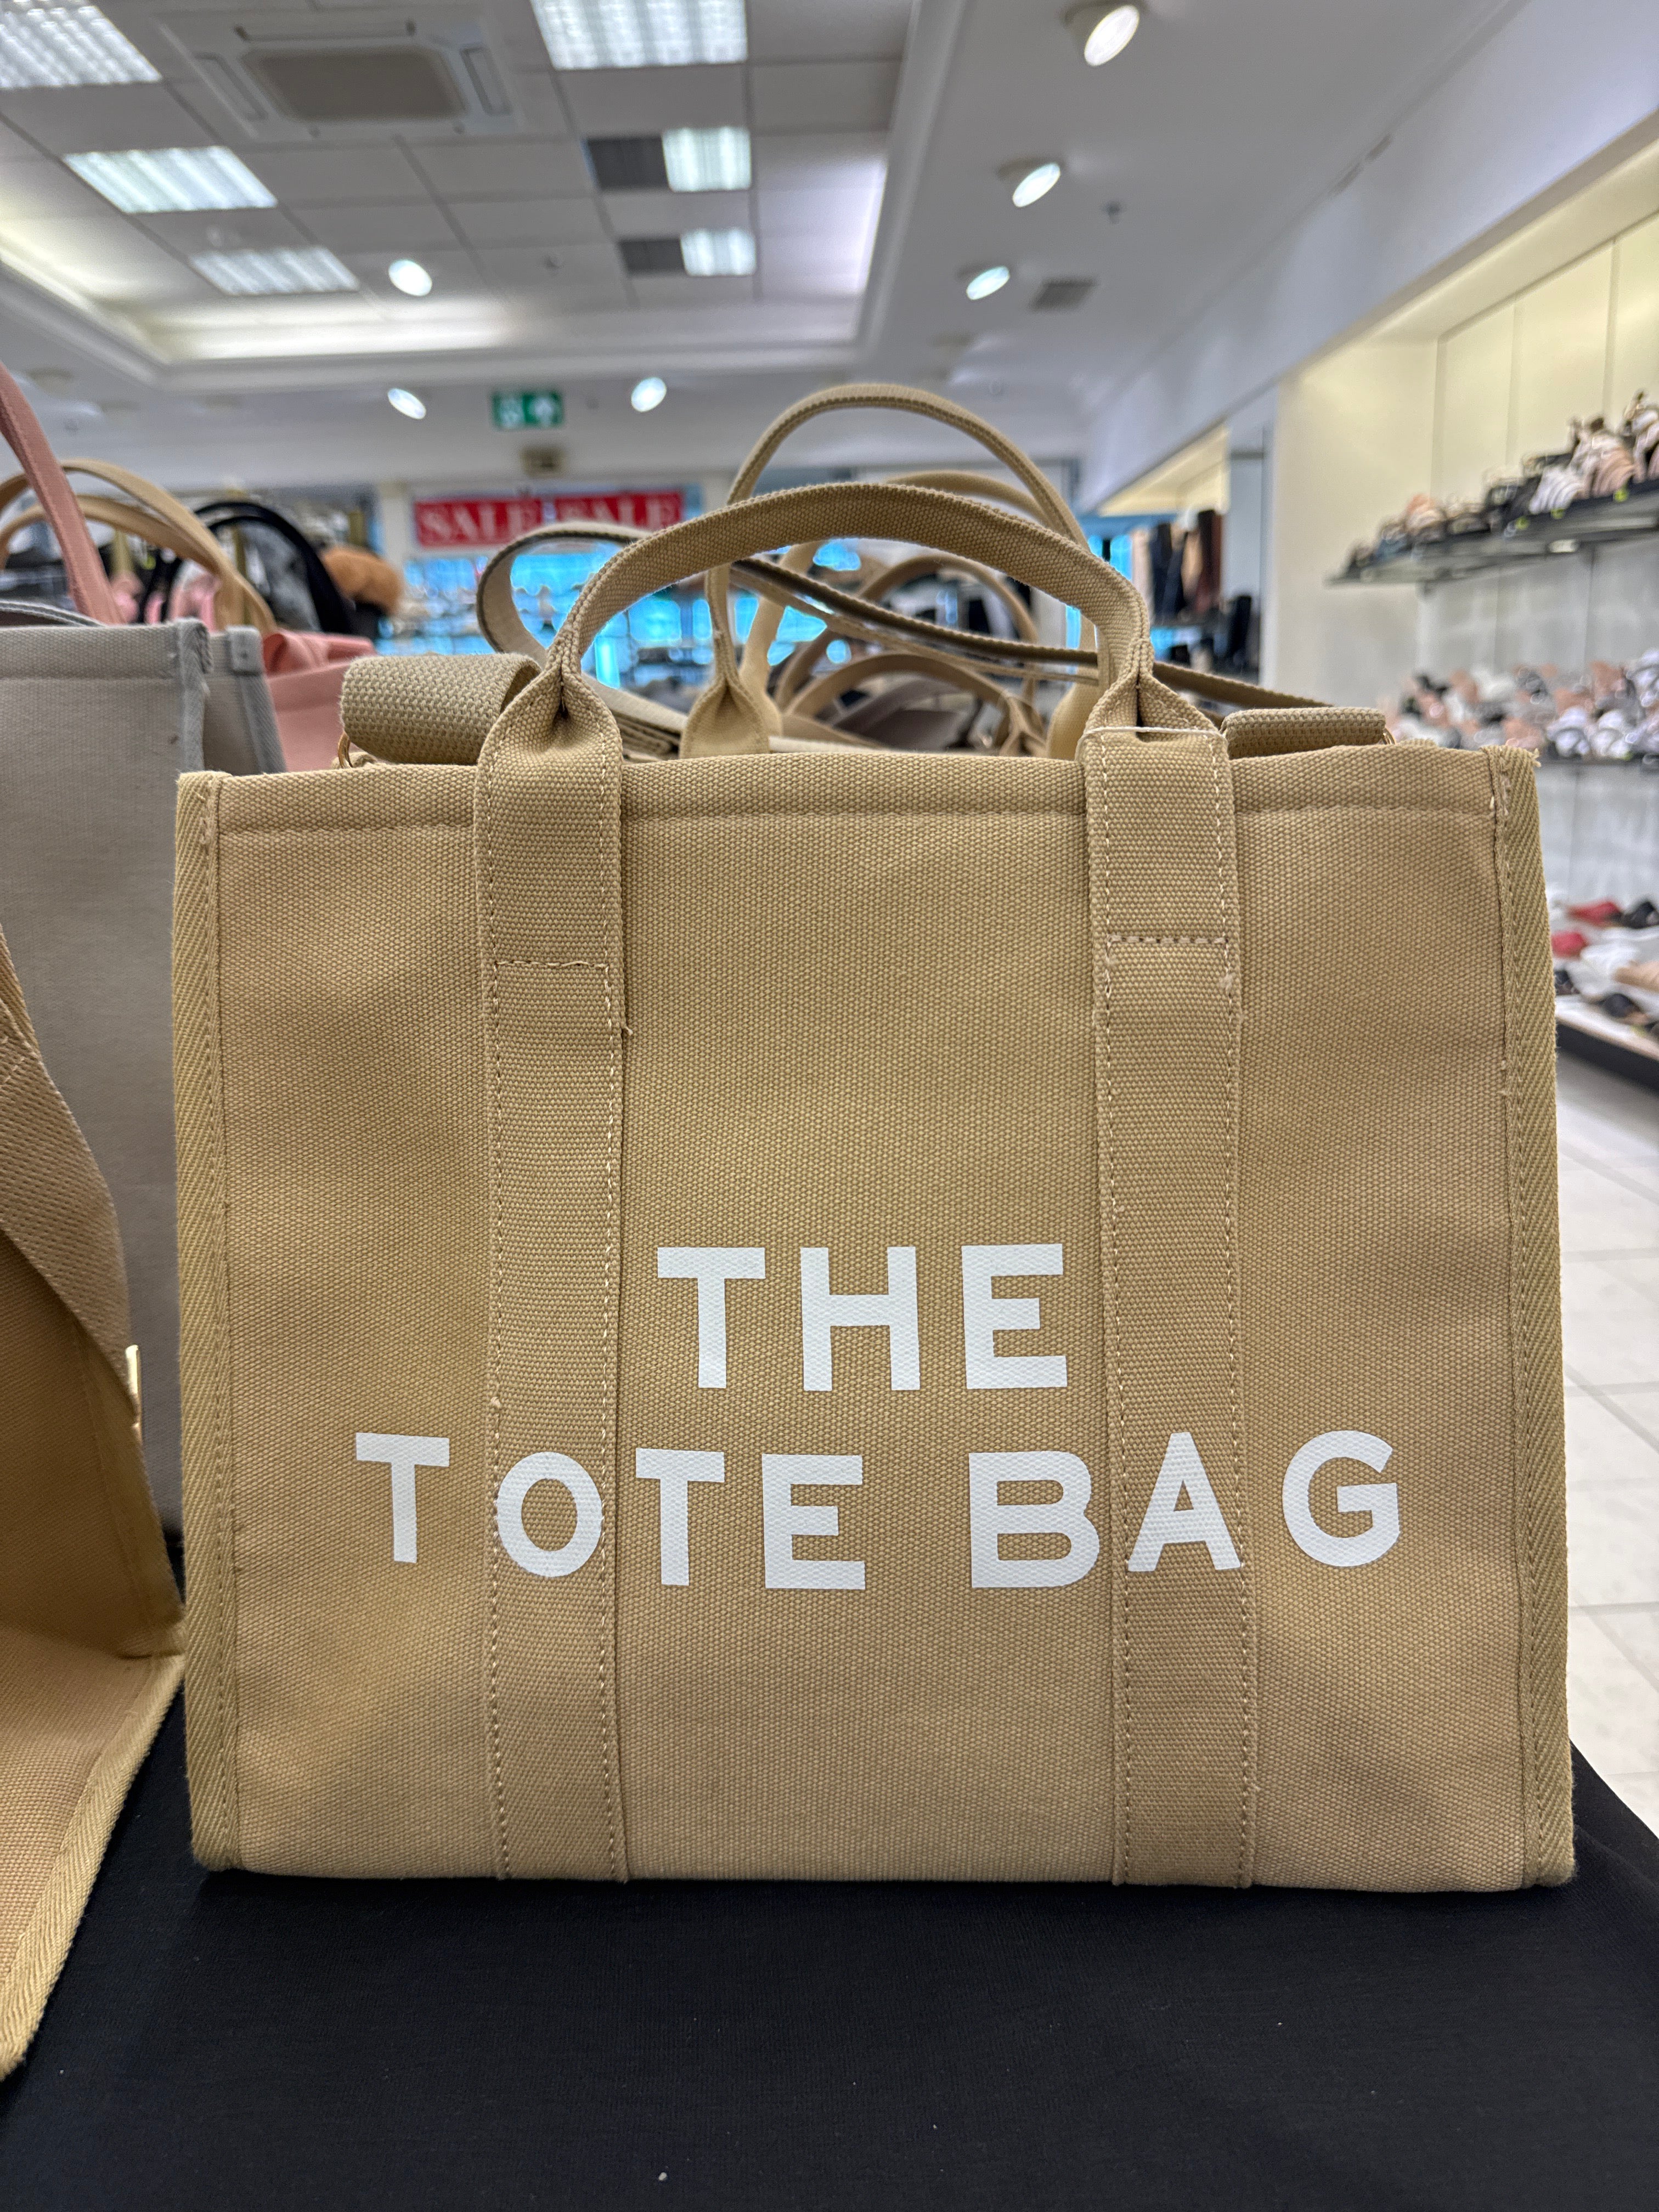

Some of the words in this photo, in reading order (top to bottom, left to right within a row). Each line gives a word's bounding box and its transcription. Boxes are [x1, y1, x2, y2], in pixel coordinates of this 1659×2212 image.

[657, 1243, 1068, 1392] THE
[356, 1432, 866, 1590] TOTE
[968, 1430, 1401, 1588] BAG
